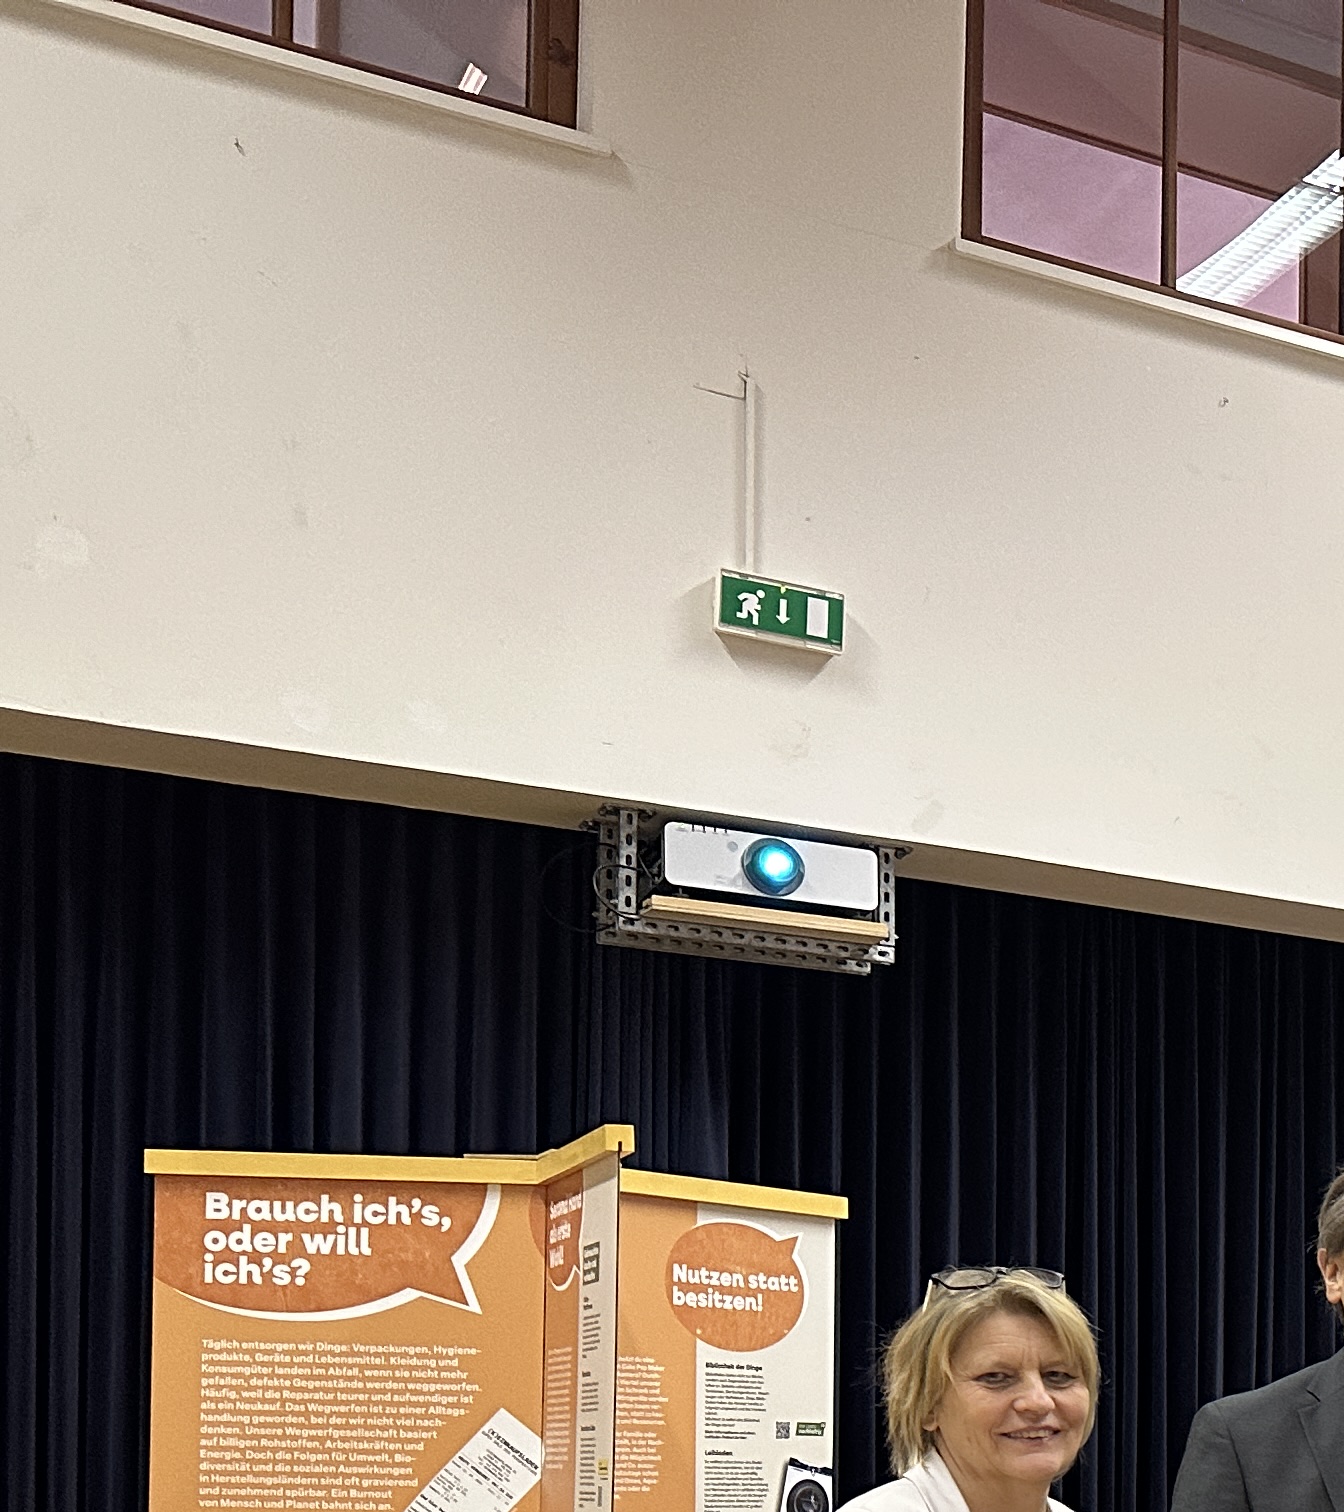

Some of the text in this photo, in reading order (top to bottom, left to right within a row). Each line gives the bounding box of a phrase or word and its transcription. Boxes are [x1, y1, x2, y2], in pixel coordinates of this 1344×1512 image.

[205, 1192, 344, 1223] Brauch
[203, 1223, 372, 1256] oder will
[203, 1252, 311, 1286] ich’s?
[672, 1263, 799, 1292] Nutzen statt
[672, 1286, 763, 1312] besitzen!
[201, 1339, 482, 1356] Täglich entsorgen wir Dinge: Verpackungen, Hygiene-
